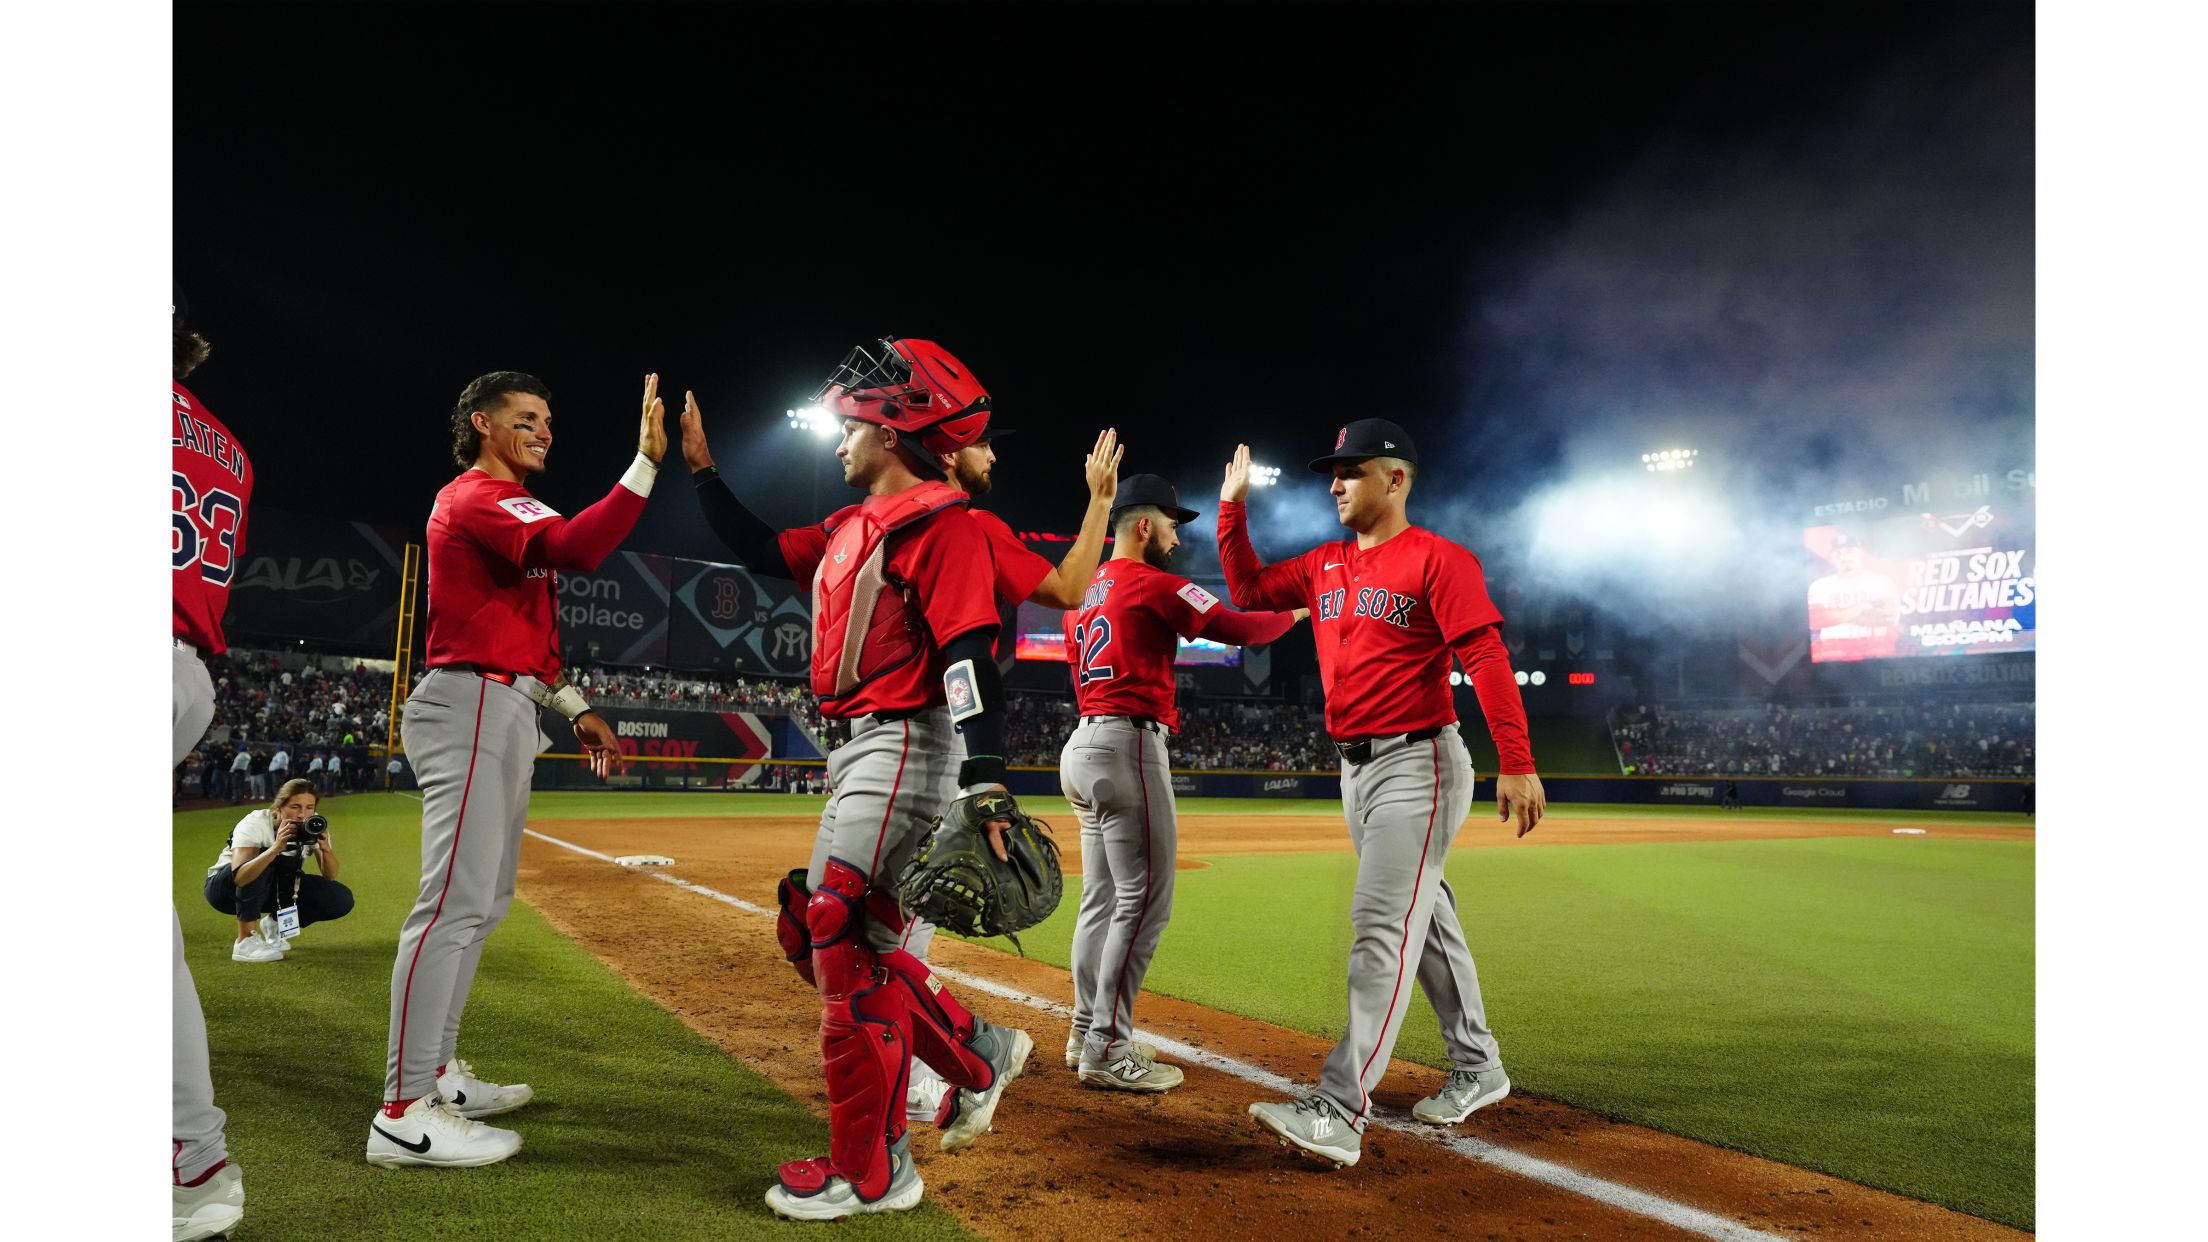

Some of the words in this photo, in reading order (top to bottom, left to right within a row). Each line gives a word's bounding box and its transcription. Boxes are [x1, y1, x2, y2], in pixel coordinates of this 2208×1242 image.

[173, 410, 245, 485] ATEN
[1814, 497, 1889, 518] ESTADIO
[233, 555, 346, 592] ALA
[1906, 555, 1961, 587] RED
[1966, 549, 2026, 583] SOX
[1316, 587, 1346, 622] ED
[1354, 586, 1418, 629] SOX
[1900, 577, 2035, 616] SULTANES
[1910, 617, 2023, 638] MAÑANA
[1074, 615, 1114, 687] 12
[617, 720, 668, 738] BOSTON
[643, 738, 699, 771] SOX
[1782, 786, 1817, 799] Google
[1818, 787, 1846, 798] Cloud
